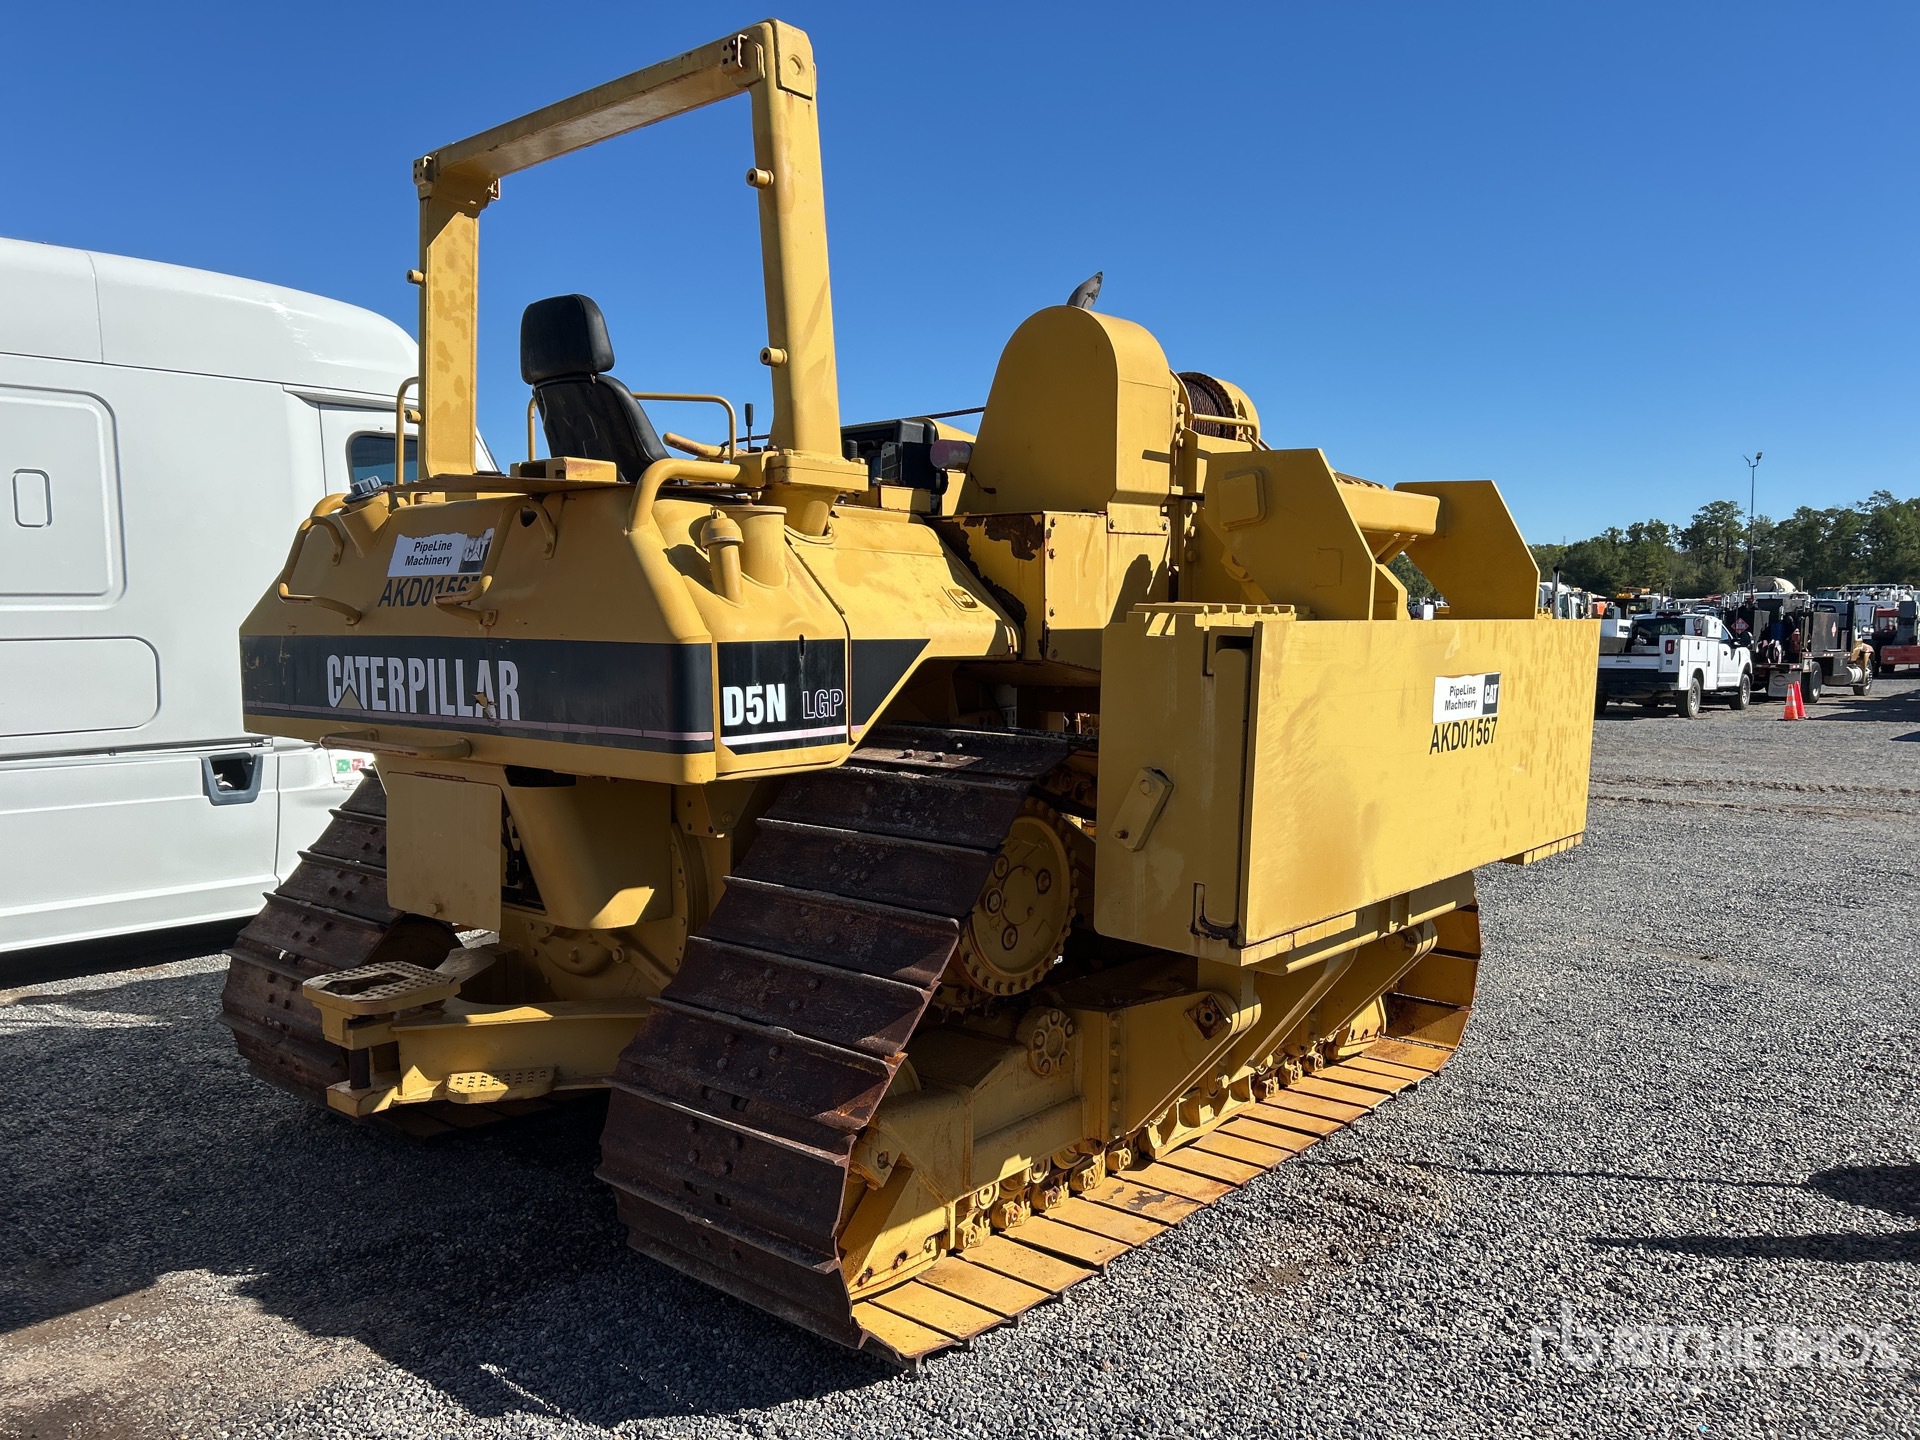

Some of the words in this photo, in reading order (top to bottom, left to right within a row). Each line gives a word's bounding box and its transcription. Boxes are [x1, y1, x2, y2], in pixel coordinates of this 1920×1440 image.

[413, 540, 452, 553] PipeLine
[404, 554, 453, 567] Machinery
[326, 654, 521, 721] CATERPILLAR
[1449, 684, 1476, 698] PipeLine
[1484, 684, 1499, 704] CAT
[722, 683, 787, 726] D5N
[802, 688, 844, 720] LGP
[1444, 699, 1478, 711] Machinery
[1429, 716, 1498, 755] AKD01567
